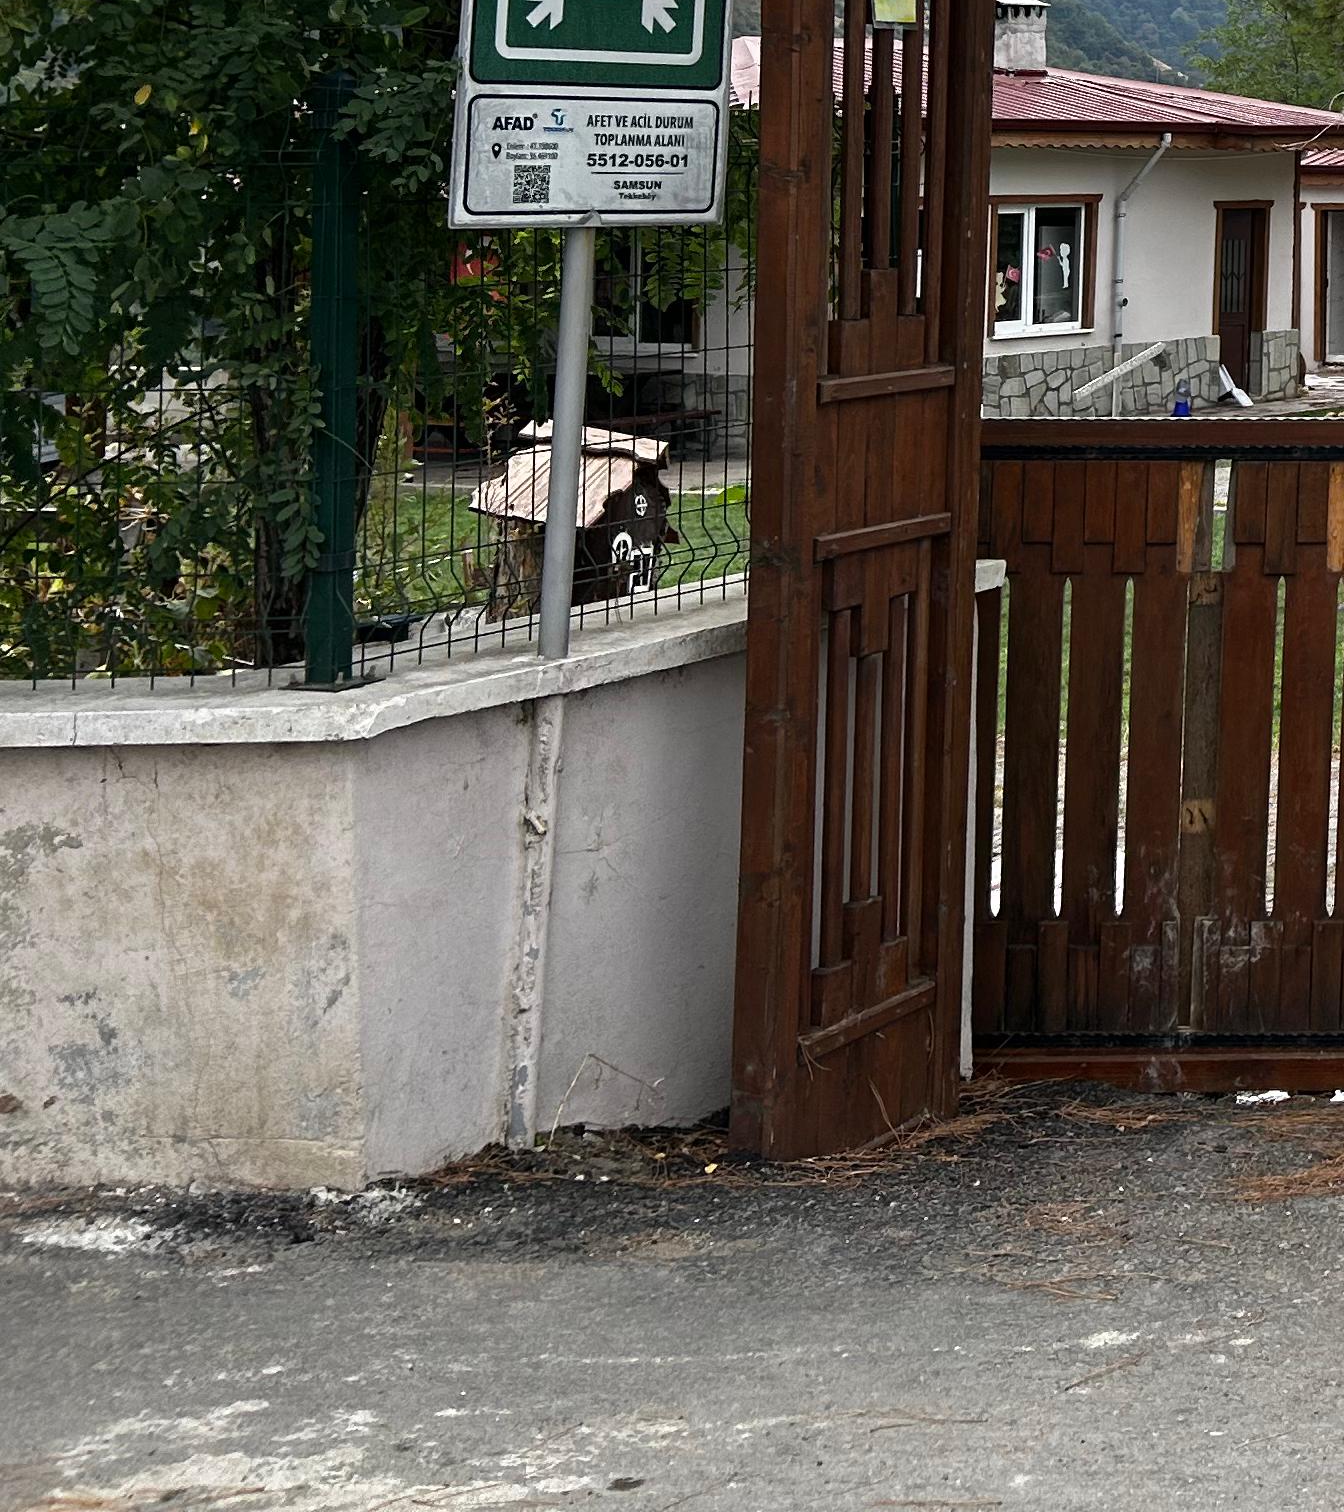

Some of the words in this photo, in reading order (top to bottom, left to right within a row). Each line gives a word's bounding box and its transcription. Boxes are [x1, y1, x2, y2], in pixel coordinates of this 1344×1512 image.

[492, 116, 534, 131] AFAD
[586, 114, 613, 128] AFET
[615, 115, 628, 128] VE
[630, 113, 652, 129] ACİL
[655, 116, 694, 129] DURUM
[594, 133, 651, 147] TOPLANMA
[654, 134, 685, 148] ALANI
[586, 153, 688, 168] 5512-056-01
[613, 180, 662, 190] SAMSUN
